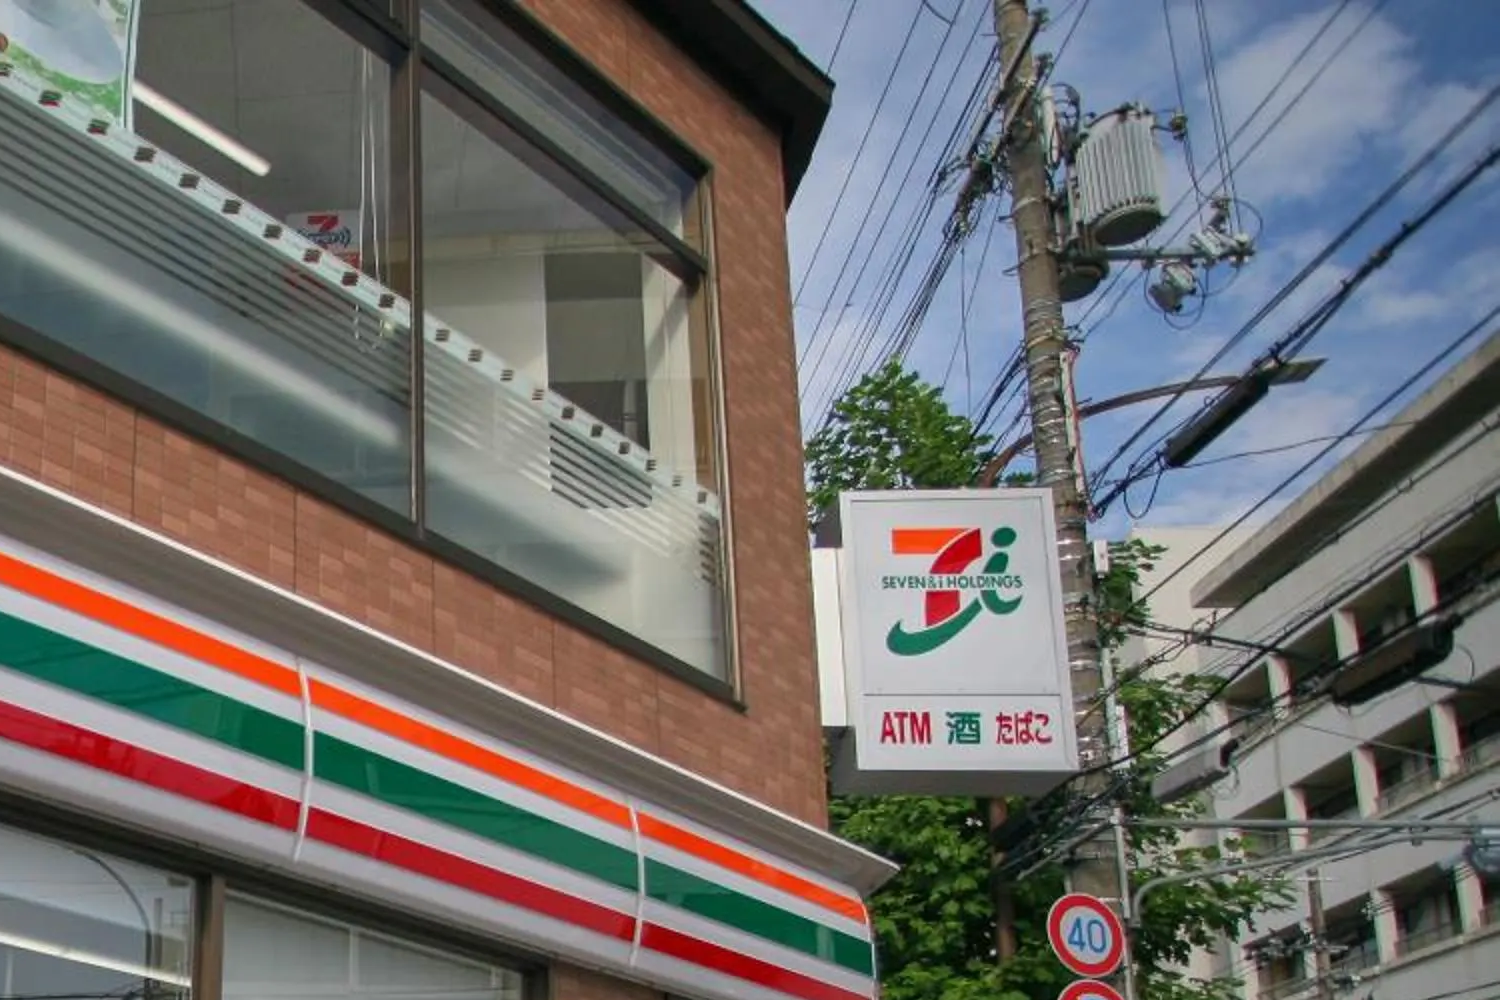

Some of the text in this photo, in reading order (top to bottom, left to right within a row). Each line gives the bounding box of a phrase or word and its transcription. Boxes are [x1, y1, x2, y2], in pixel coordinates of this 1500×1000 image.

[947, 575, 1023, 589] HOLDINGS
[880, 710, 1053, 744] ATM 酒 たばこ
[1067, 916, 1108, 953] 40
